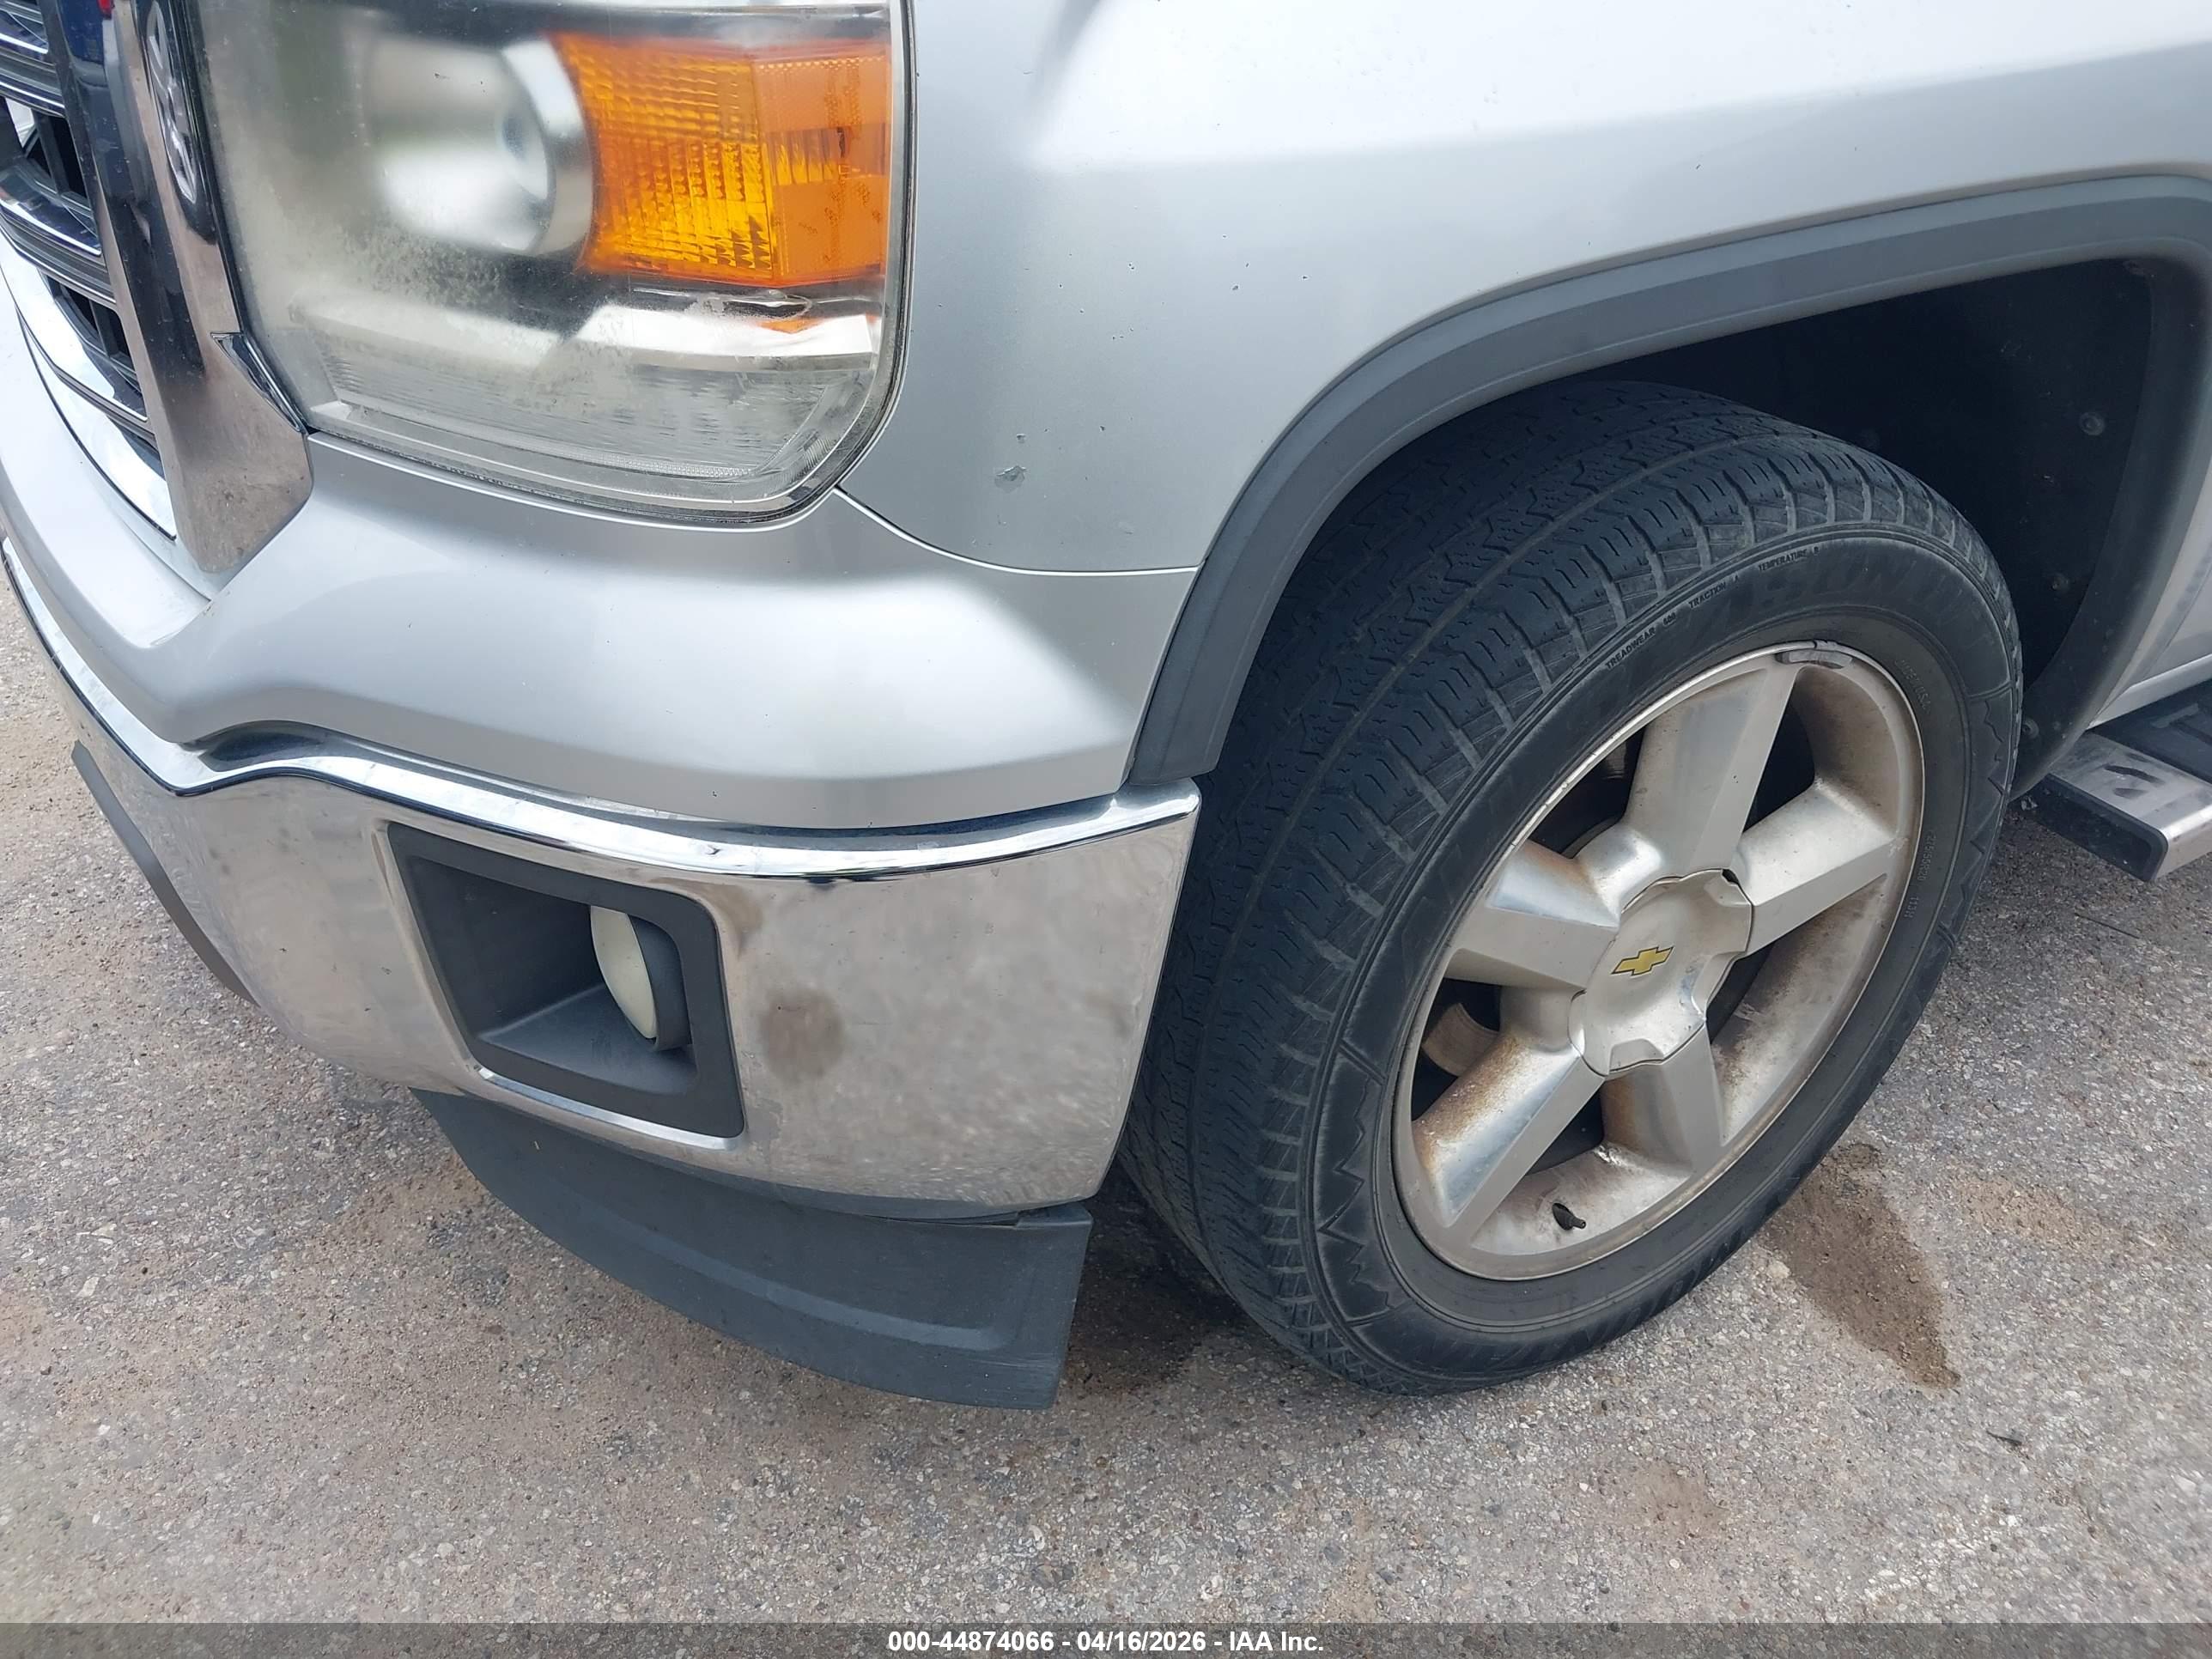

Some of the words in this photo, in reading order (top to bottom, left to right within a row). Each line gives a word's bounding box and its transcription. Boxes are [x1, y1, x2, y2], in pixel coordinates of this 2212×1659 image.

[1605, 627, 1656, 669] TREADWEAR
[1688, 581, 1726, 608] TRACTION
[1758, 548, 1808, 571] TEMPERATURE
